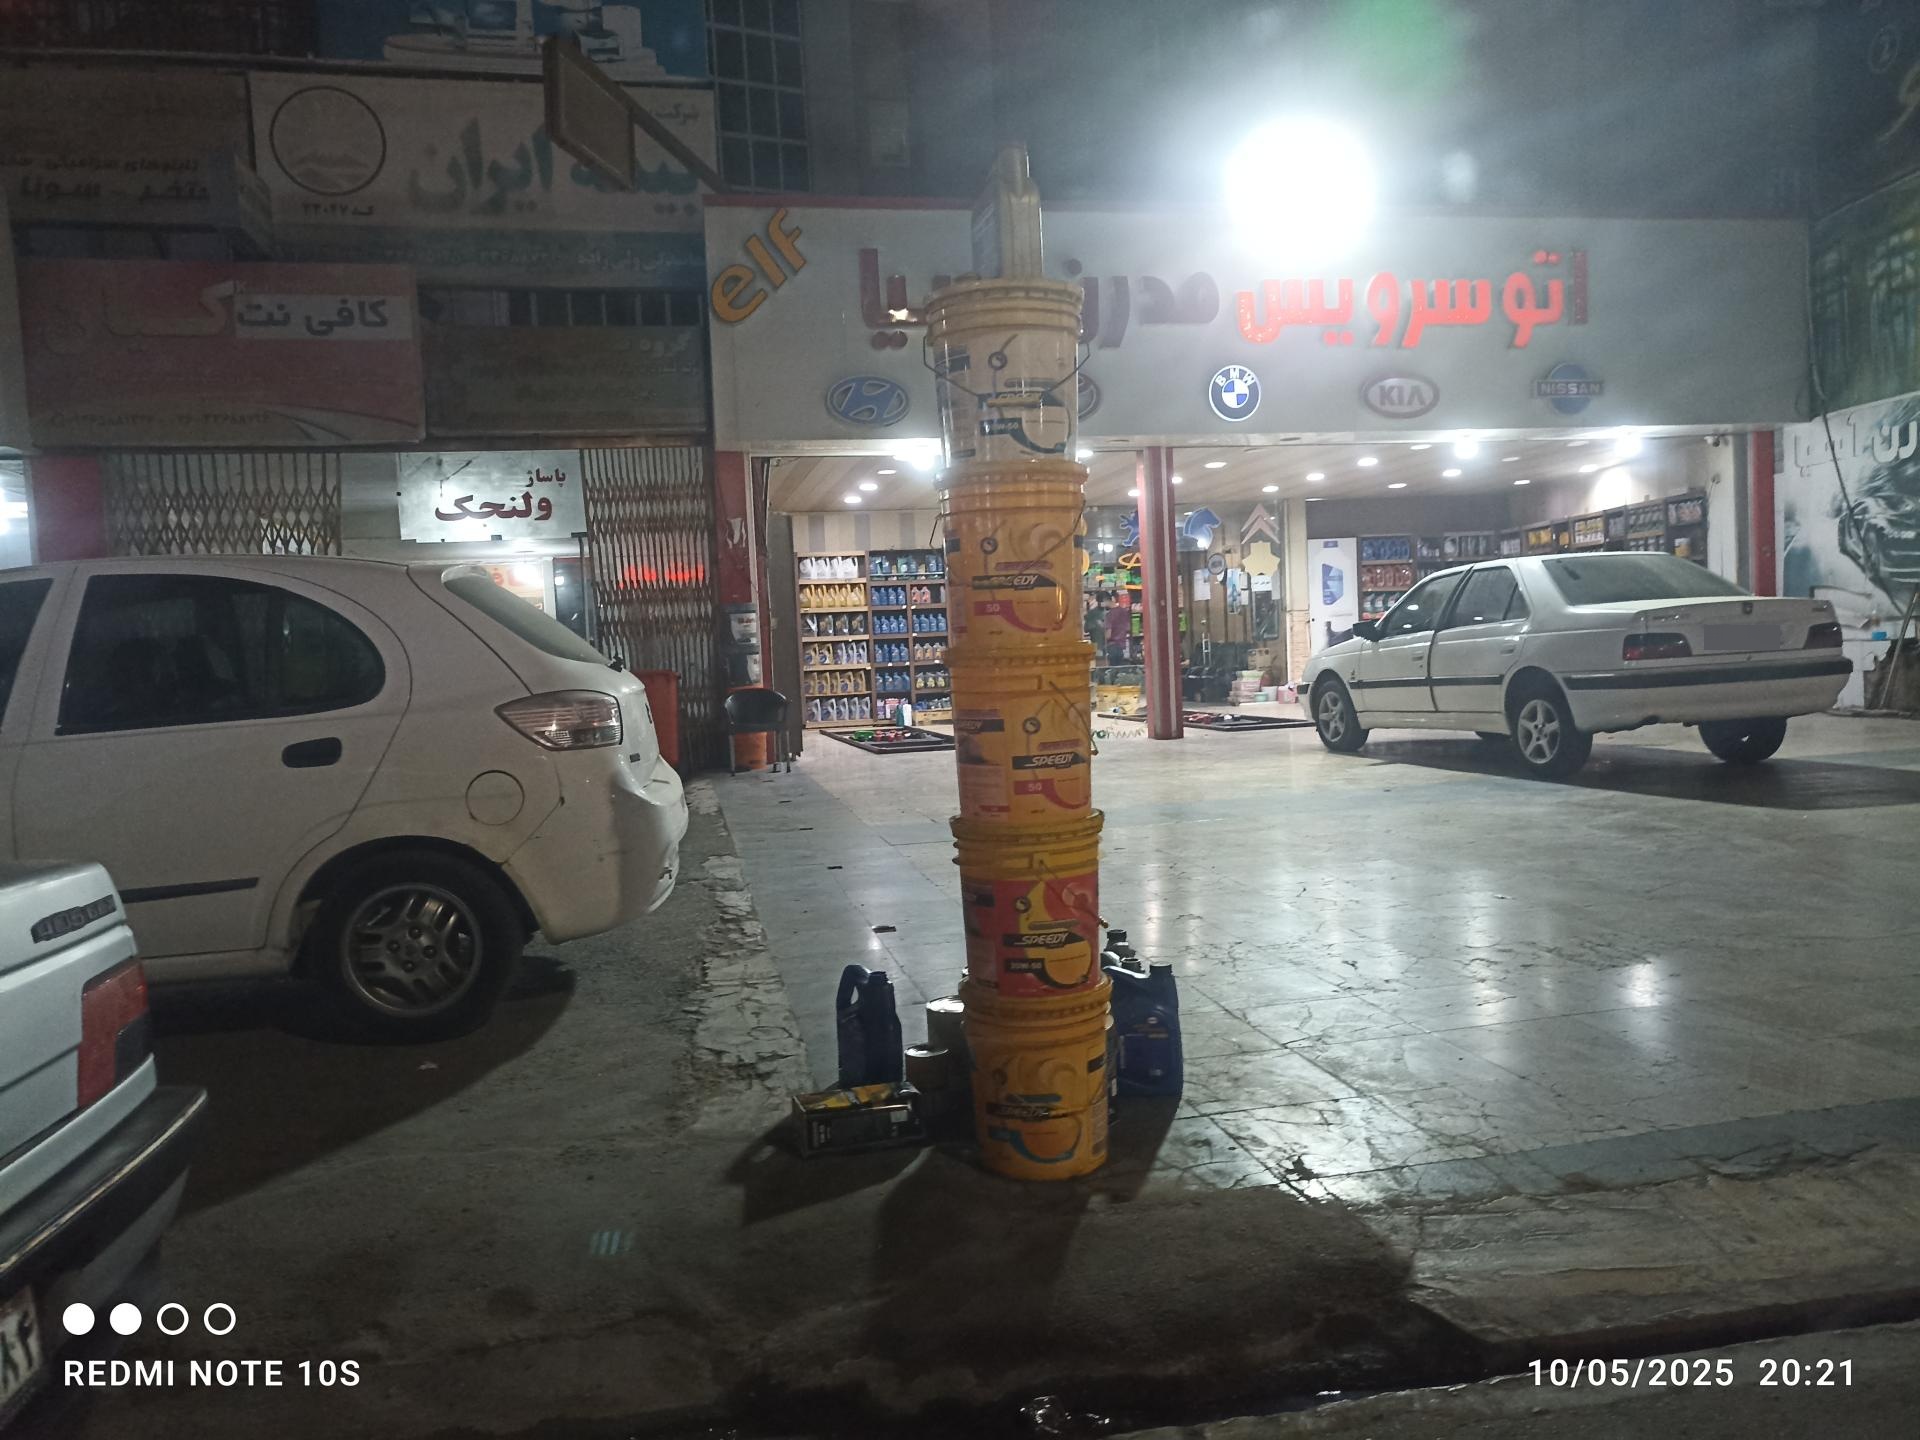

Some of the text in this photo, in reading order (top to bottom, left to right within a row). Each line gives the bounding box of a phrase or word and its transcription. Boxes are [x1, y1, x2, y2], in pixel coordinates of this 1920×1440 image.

[405, 117, 554, 215] ایران
[711, 206, 807, 323] elf
[237, 299, 290, 327] نت
[305, 299, 389, 337] کافی
[1214, 366, 1256, 388] BMW
[1378, 384, 1427, 406] KIA
[1540, 382, 1602, 396] NISSAN
[525, 467, 566, 487] پاساژ
[435, 491, 553, 528] ولنجک
[1023, 753, 1074, 768] SPEEDY
[1013, 933, 1069, 946] SPEEDY
